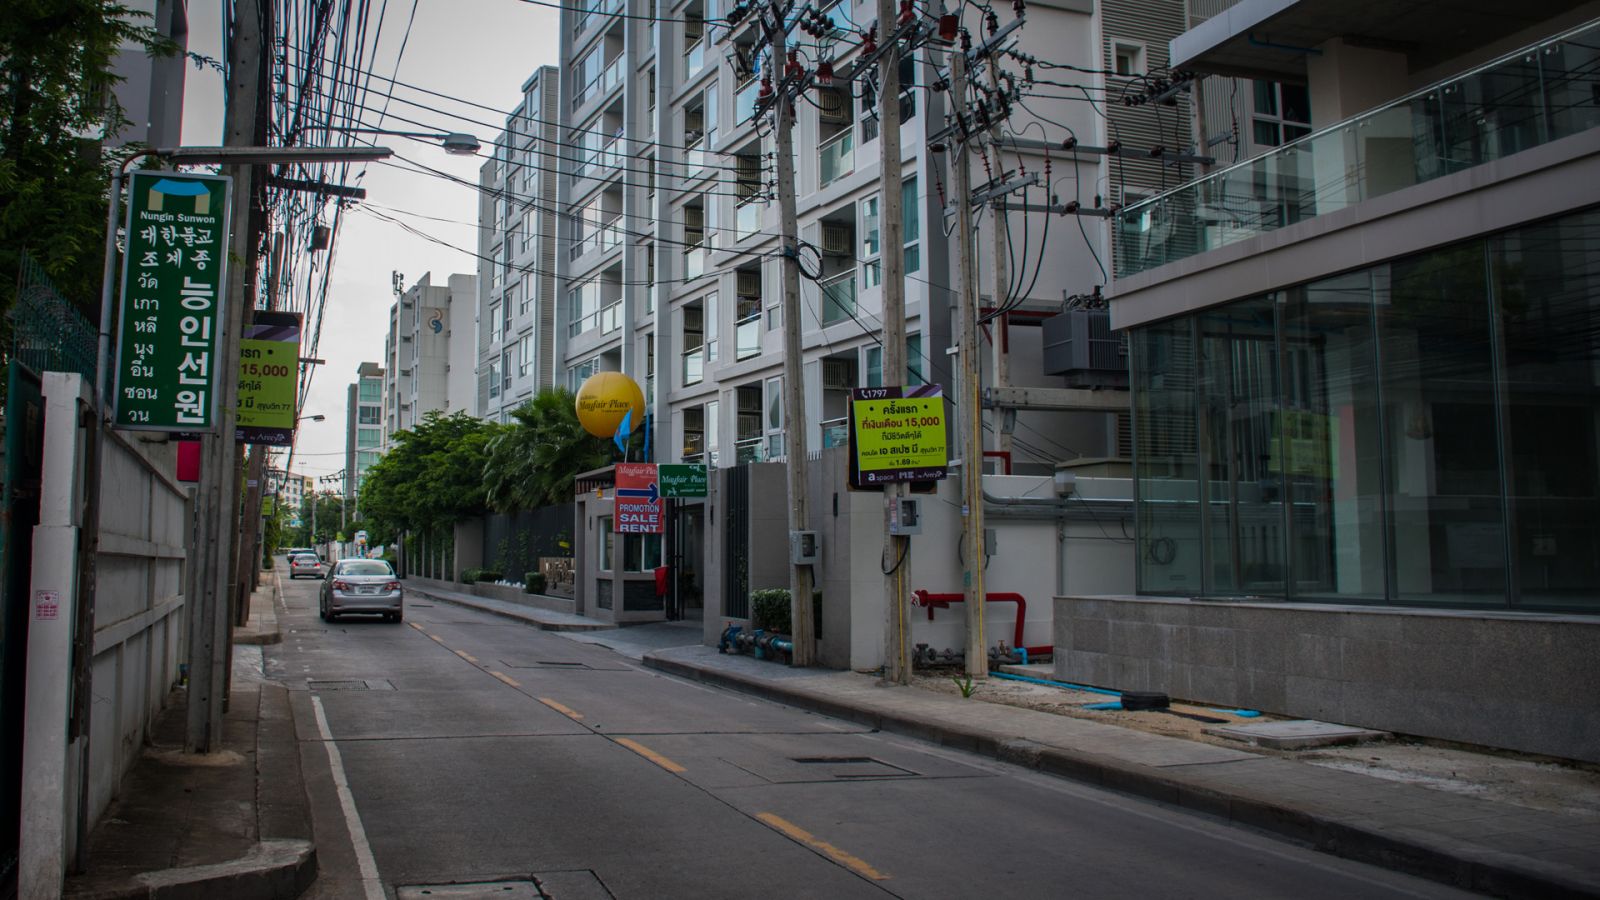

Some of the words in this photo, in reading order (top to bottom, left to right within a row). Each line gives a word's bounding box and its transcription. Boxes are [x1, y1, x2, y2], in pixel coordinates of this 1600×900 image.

[140, 211, 174, 222] Nungin
[177, 213, 215, 224] Sunwon
[139, 225, 214, 248] 대한불교
[137, 272, 158, 289] วัด
[133, 297, 159, 311] เกา
[174, 276, 214, 424] 능인선원
[241, 363, 288, 377] 15,000
[125, 386, 158, 400] ซอน
[867, 389, 887, 399] 1797
[128, 410, 150, 423] วน
[905, 416, 940, 428] 15,000
[619, 503, 660, 513] PROMOTION
[619, 513, 659, 523] SALE
[619, 524, 659, 533] RENT
